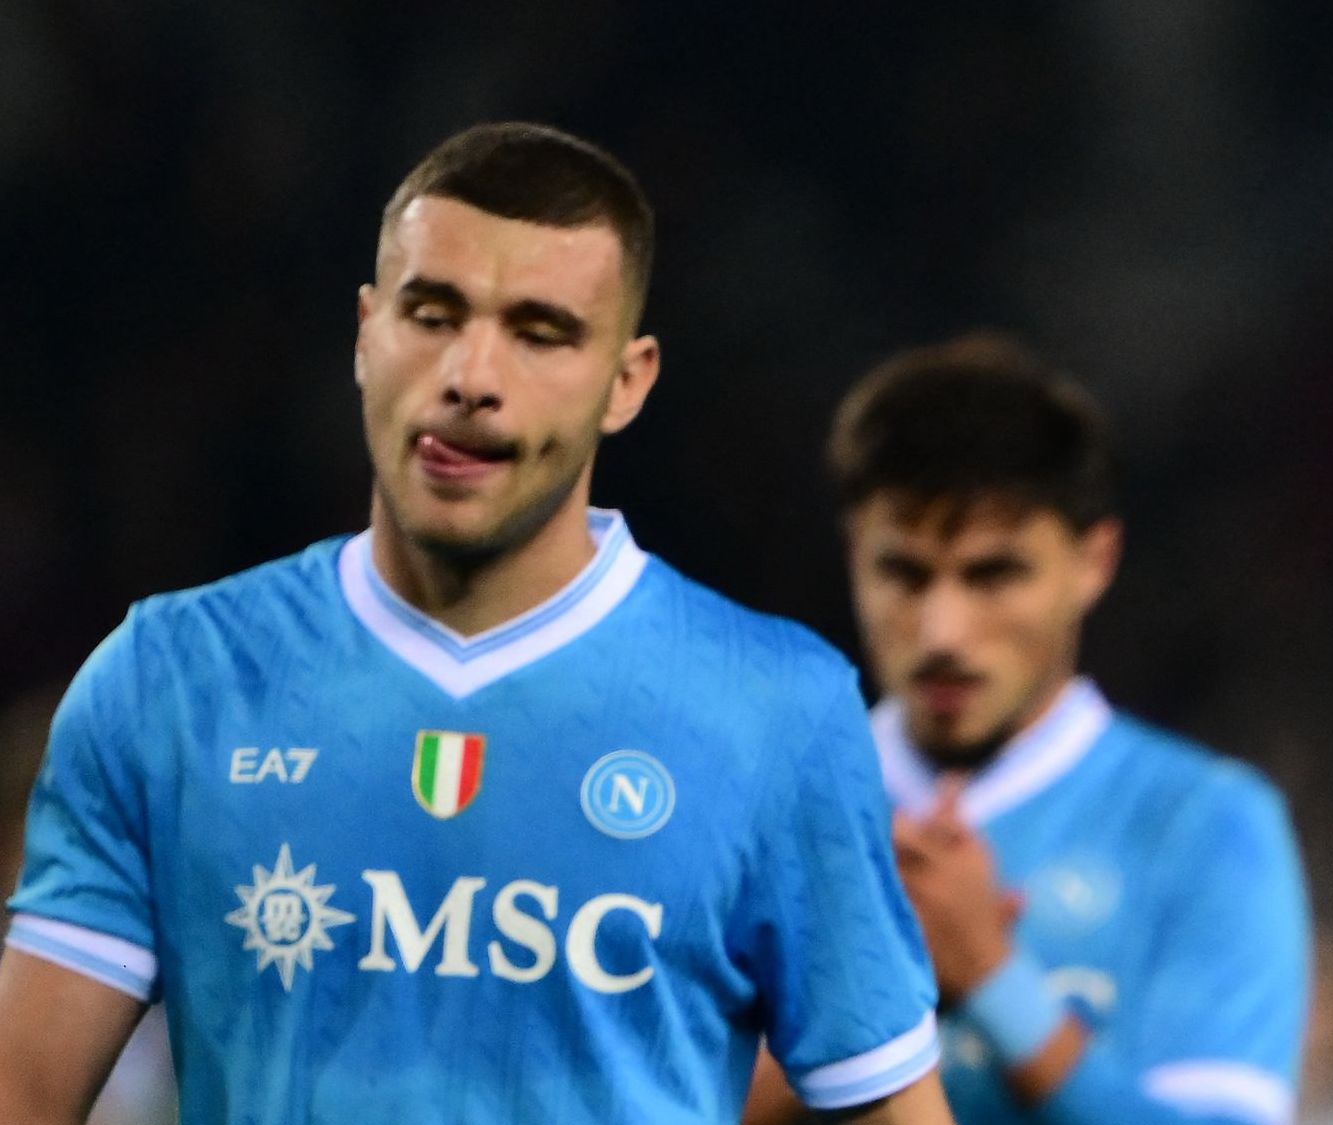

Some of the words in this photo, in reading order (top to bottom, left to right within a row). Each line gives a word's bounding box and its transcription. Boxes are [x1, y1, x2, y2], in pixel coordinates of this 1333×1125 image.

[229, 747, 319, 783] EA7
[608, 773, 649, 816] N
[357, 869, 664, 994] MSC
